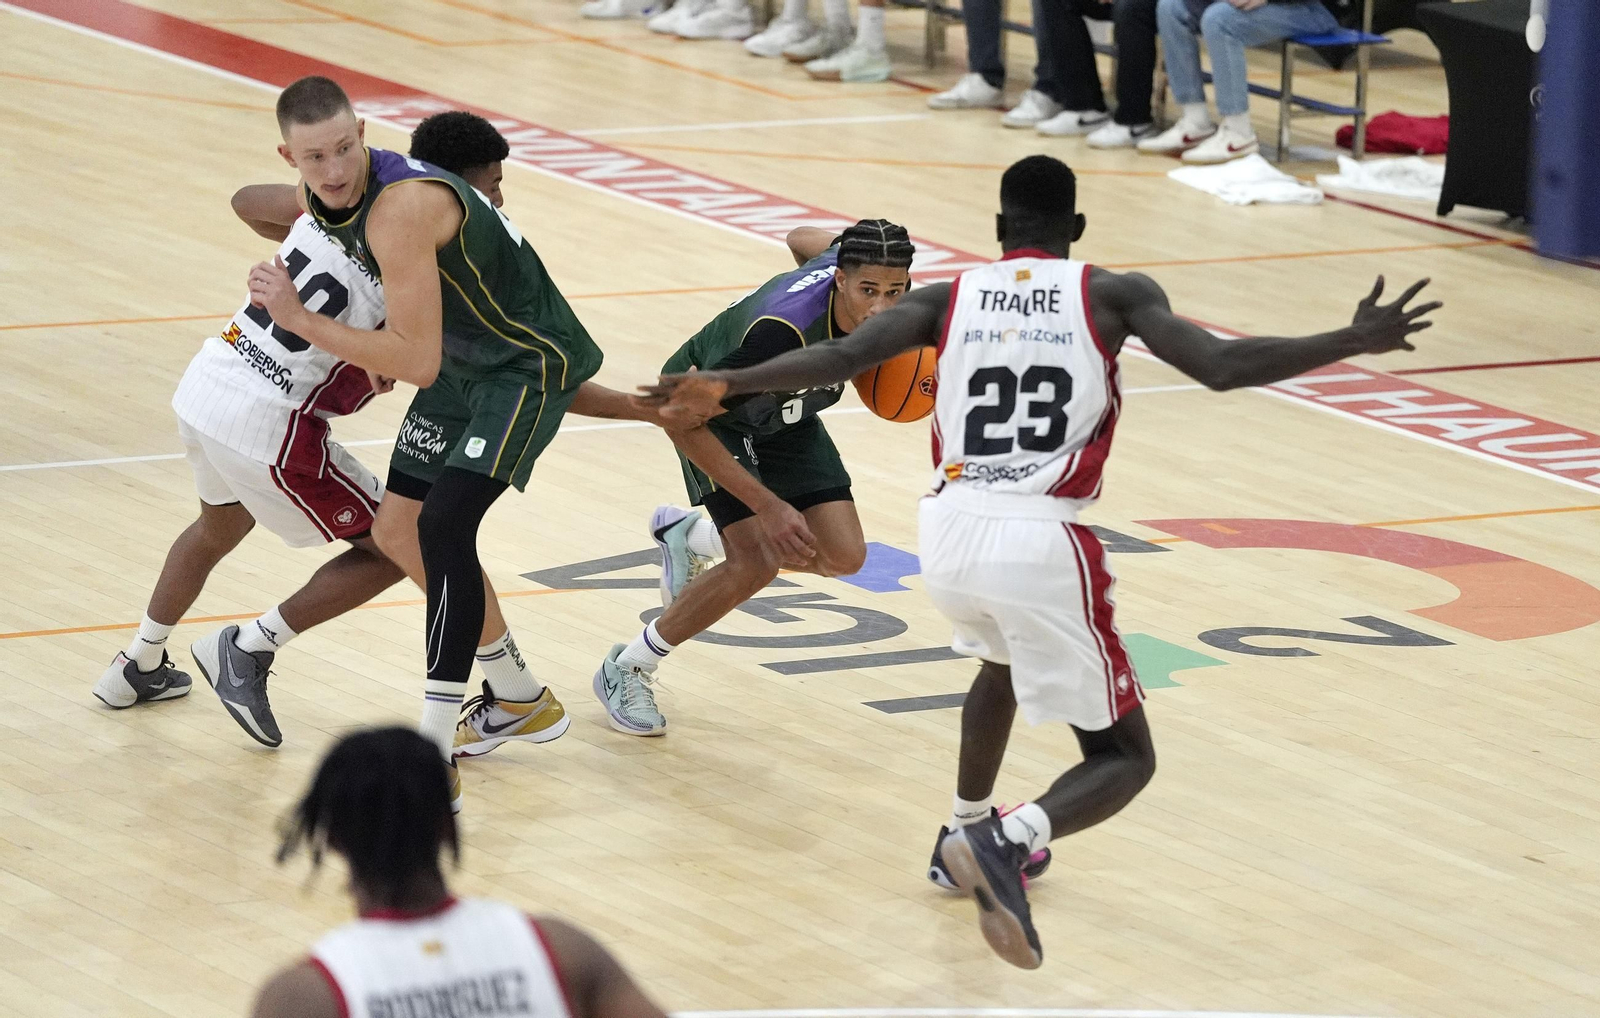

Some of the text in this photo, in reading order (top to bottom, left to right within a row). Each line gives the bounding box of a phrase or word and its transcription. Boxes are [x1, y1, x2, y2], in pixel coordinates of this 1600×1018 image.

[963, 329, 983, 345] AIR
[963, 364, 1073, 456] 23
[1266, 372, 1600, 484] LHAU
[397, 441, 430, 464] DENTAL
